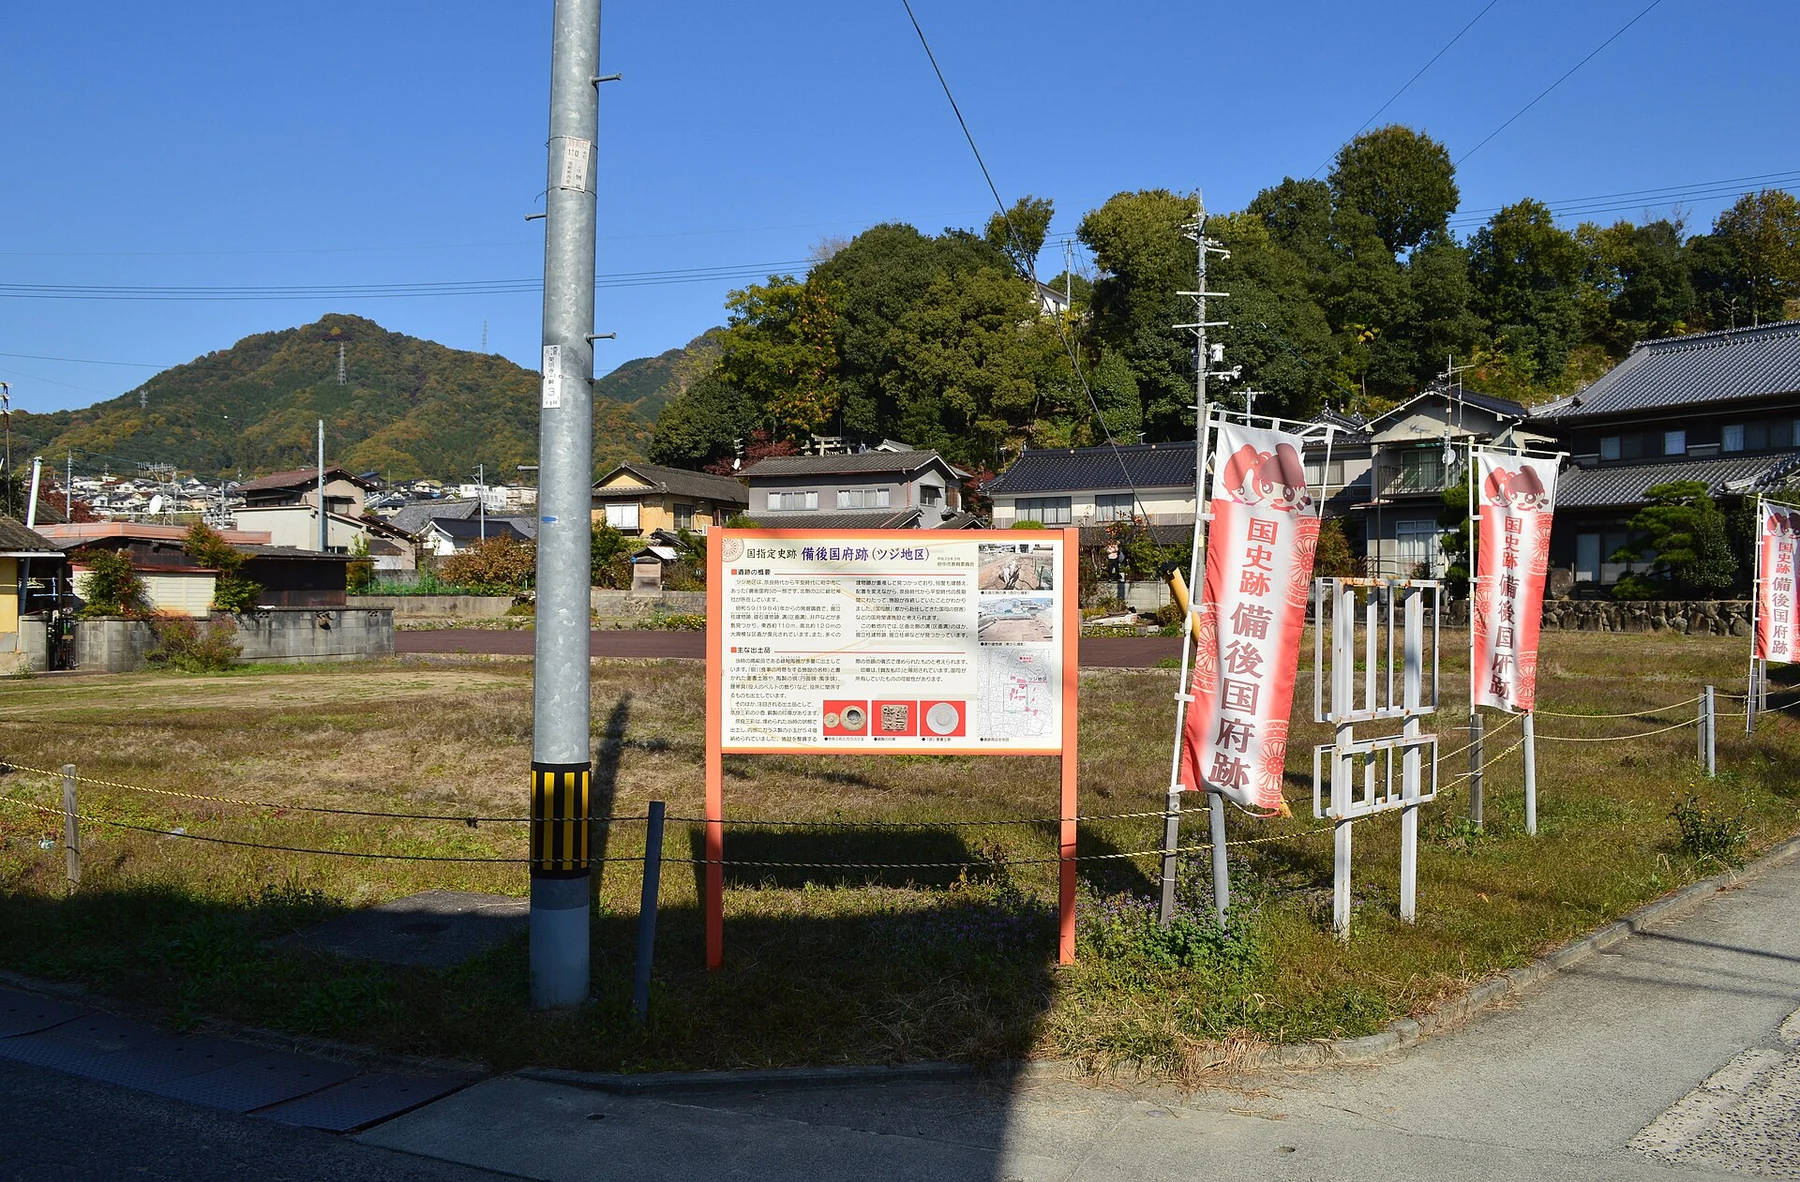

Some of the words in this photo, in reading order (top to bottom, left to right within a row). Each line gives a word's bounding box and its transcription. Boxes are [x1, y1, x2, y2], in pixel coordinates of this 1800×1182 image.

[747, 548, 797, 559] 国指定史跡
[1239, 516, 1279, 598] 国史跡
[1502, 515, 1523, 570] 国史跡
[1776, 541, 1794, 573] 国史跡
[1772, 576, 1792, 655] 備後国府跡
[1208, 601, 1274, 790] 備後国府跡
